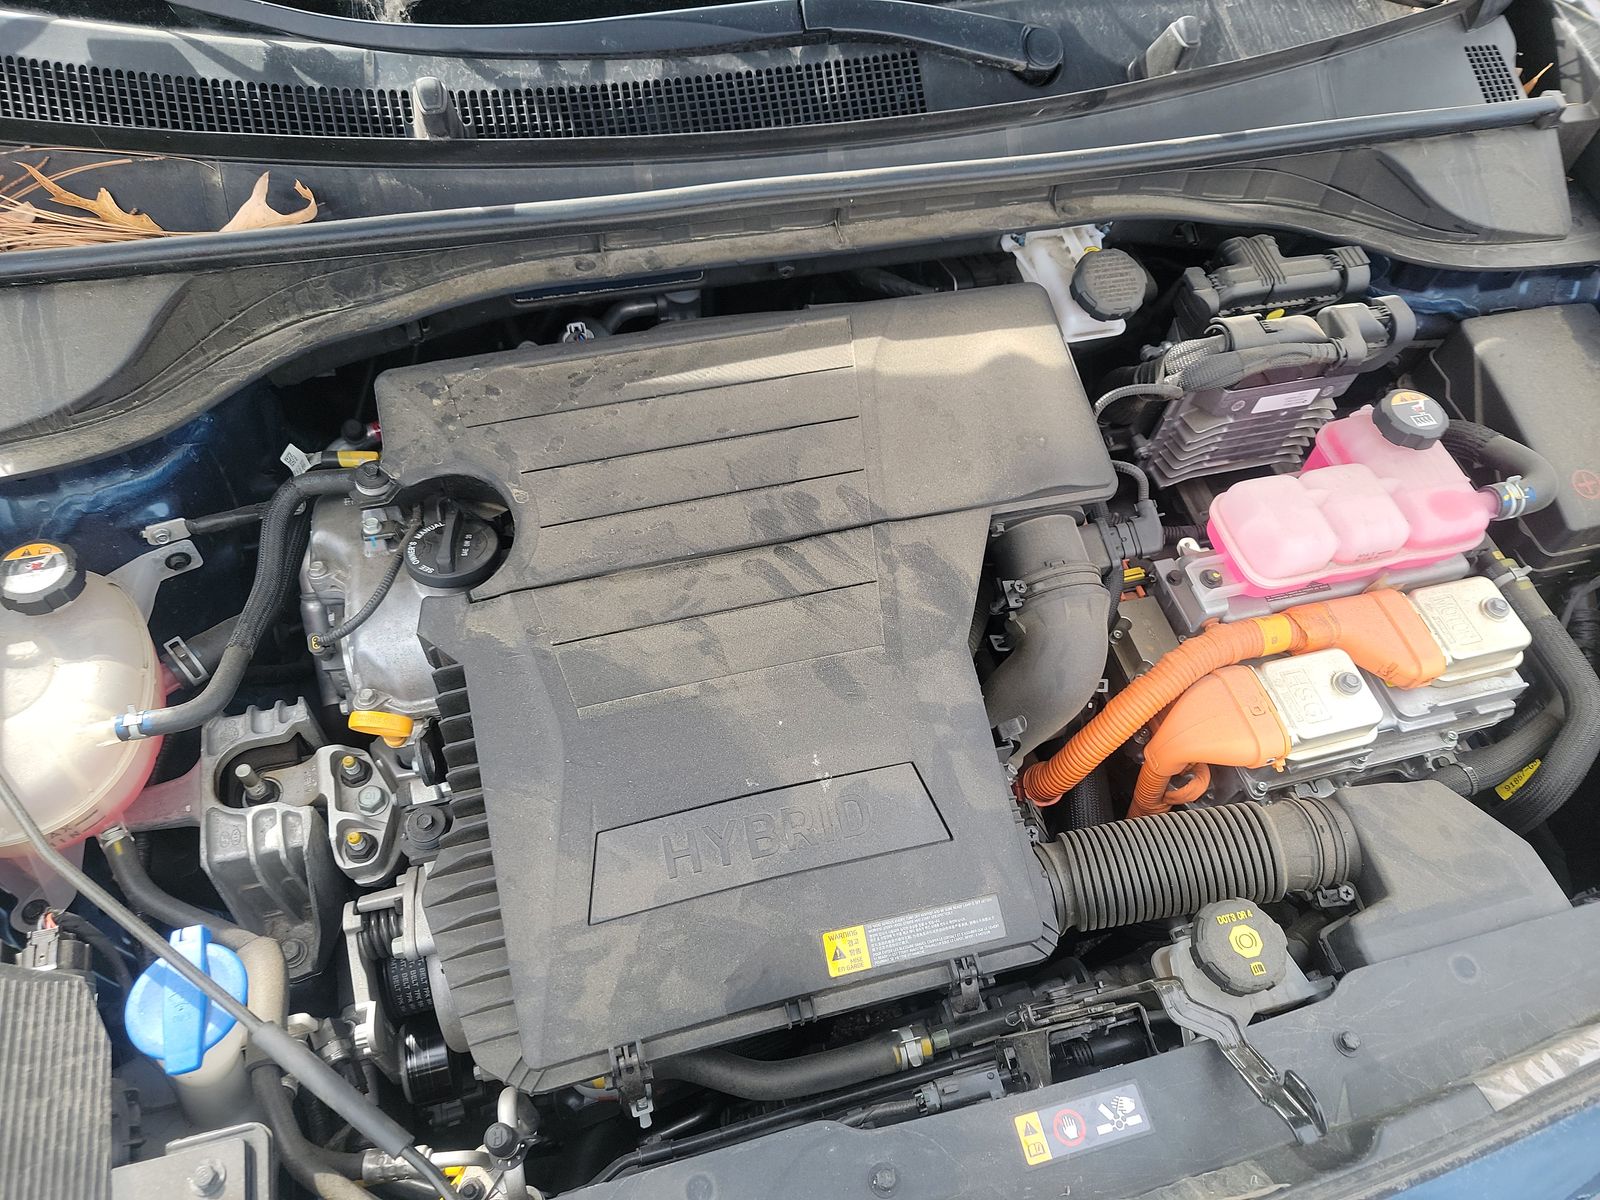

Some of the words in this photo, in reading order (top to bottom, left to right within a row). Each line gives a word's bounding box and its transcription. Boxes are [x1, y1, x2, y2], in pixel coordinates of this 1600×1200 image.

[413, 522, 446, 539] MANUAL
[418, 564, 435, 574] SEE
[660, 793, 872, 880] HYBRID
[1216, 913, 1237, 925] DOT3
[827, 929, 858, 942] WARNING
